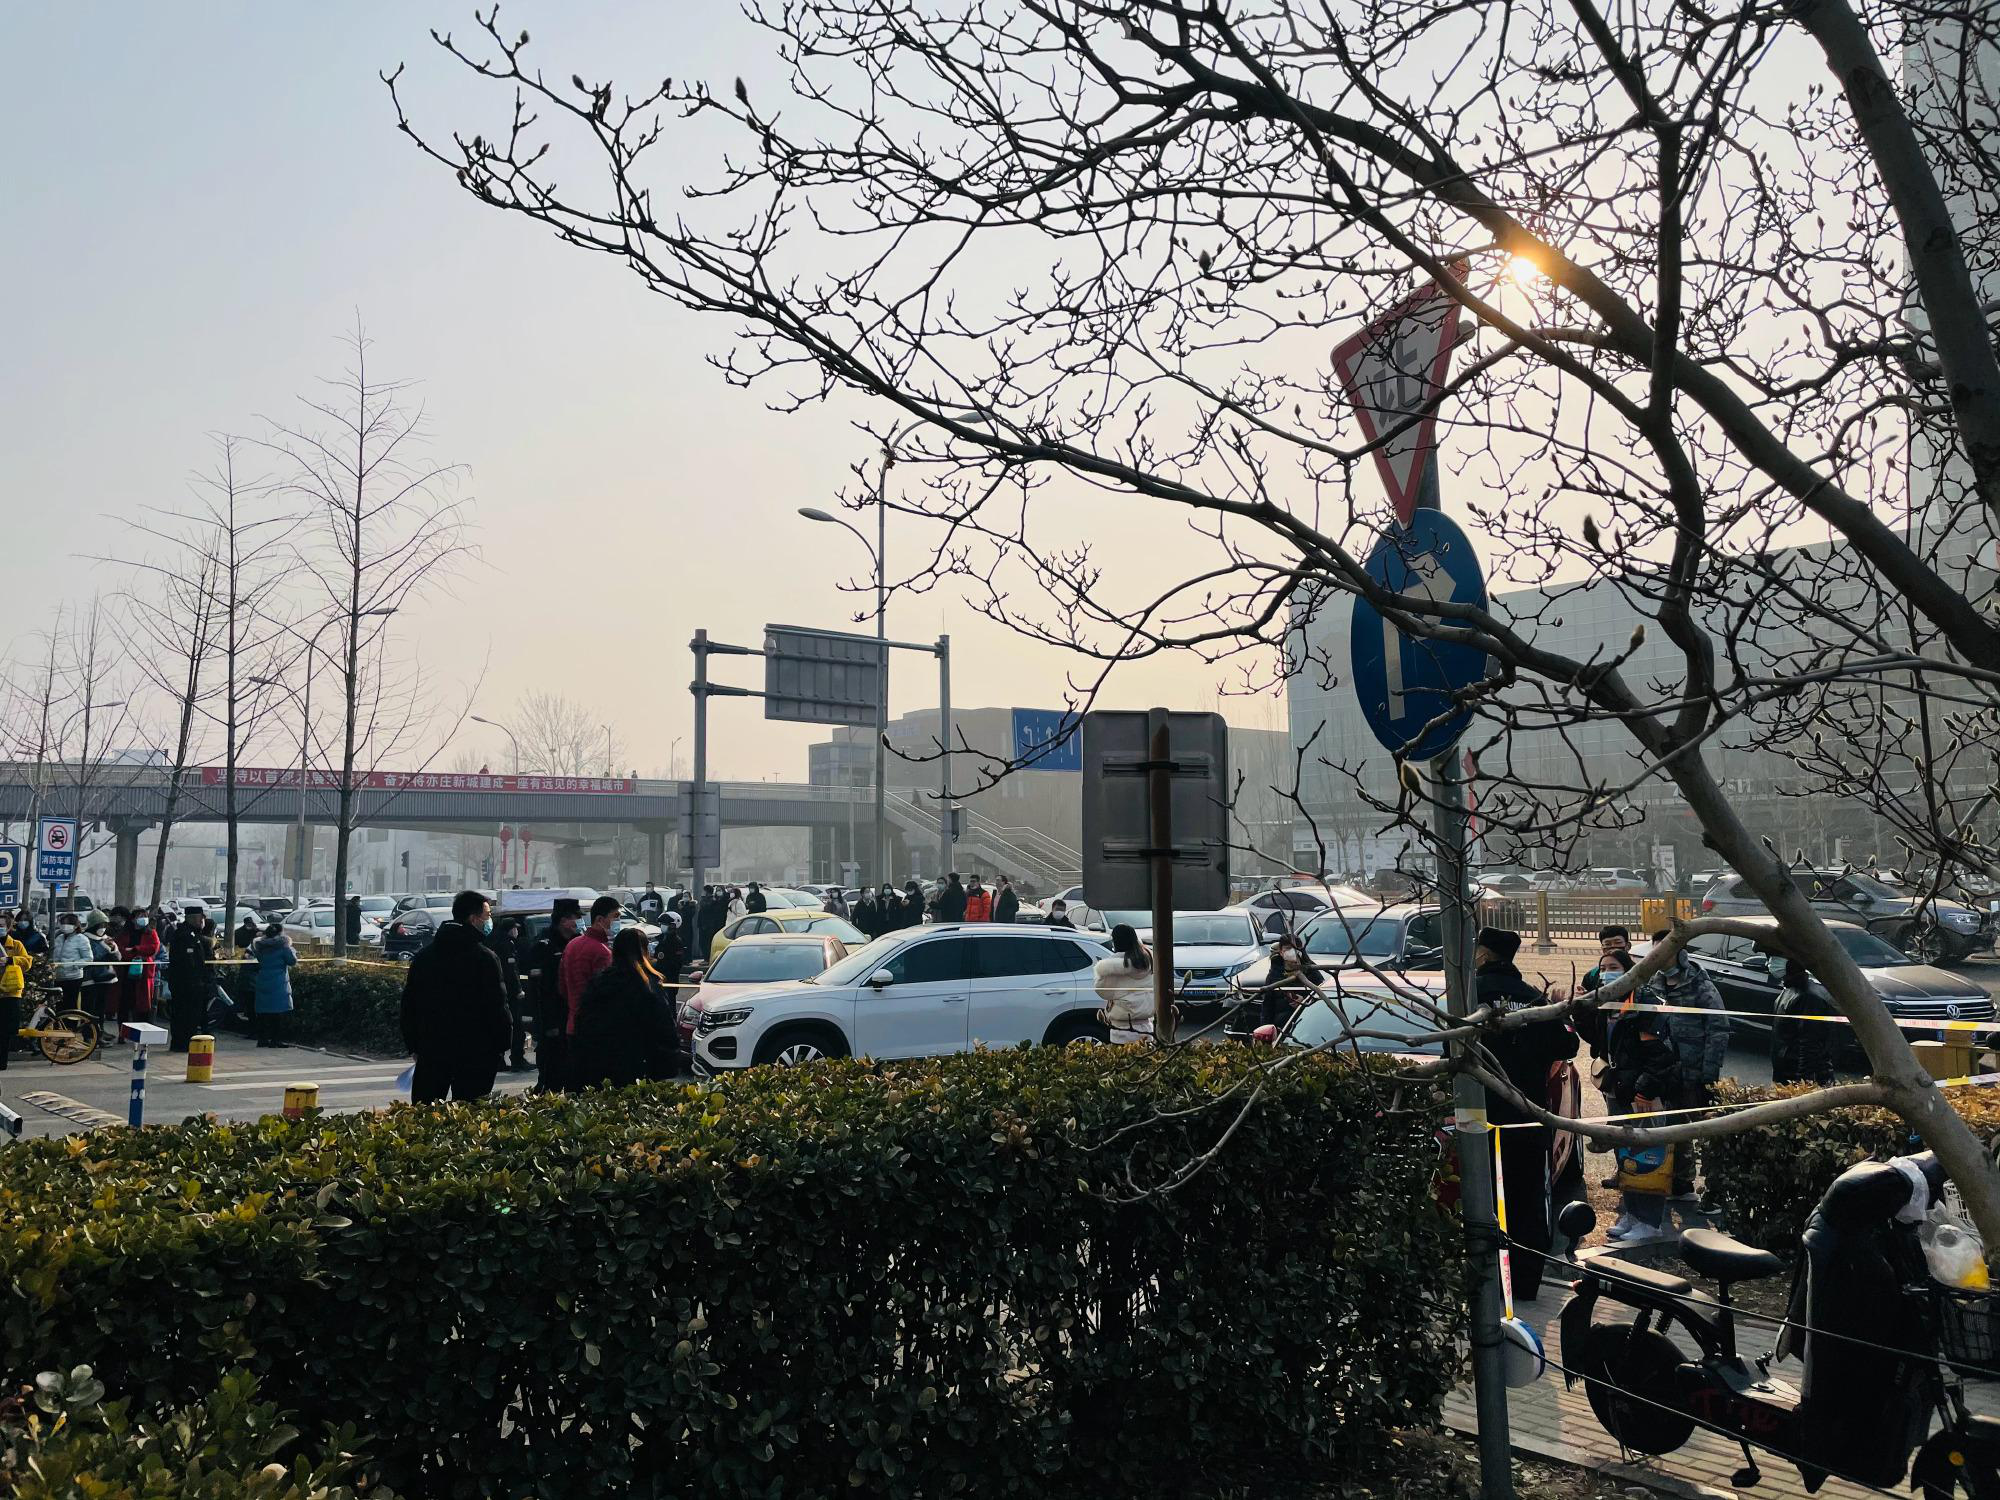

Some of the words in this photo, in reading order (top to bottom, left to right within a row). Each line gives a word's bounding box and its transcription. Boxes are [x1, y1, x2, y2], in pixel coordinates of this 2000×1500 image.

[41, 854, 72, 866] 消防车道
[41, 867, 71, 876] 禁止停车
